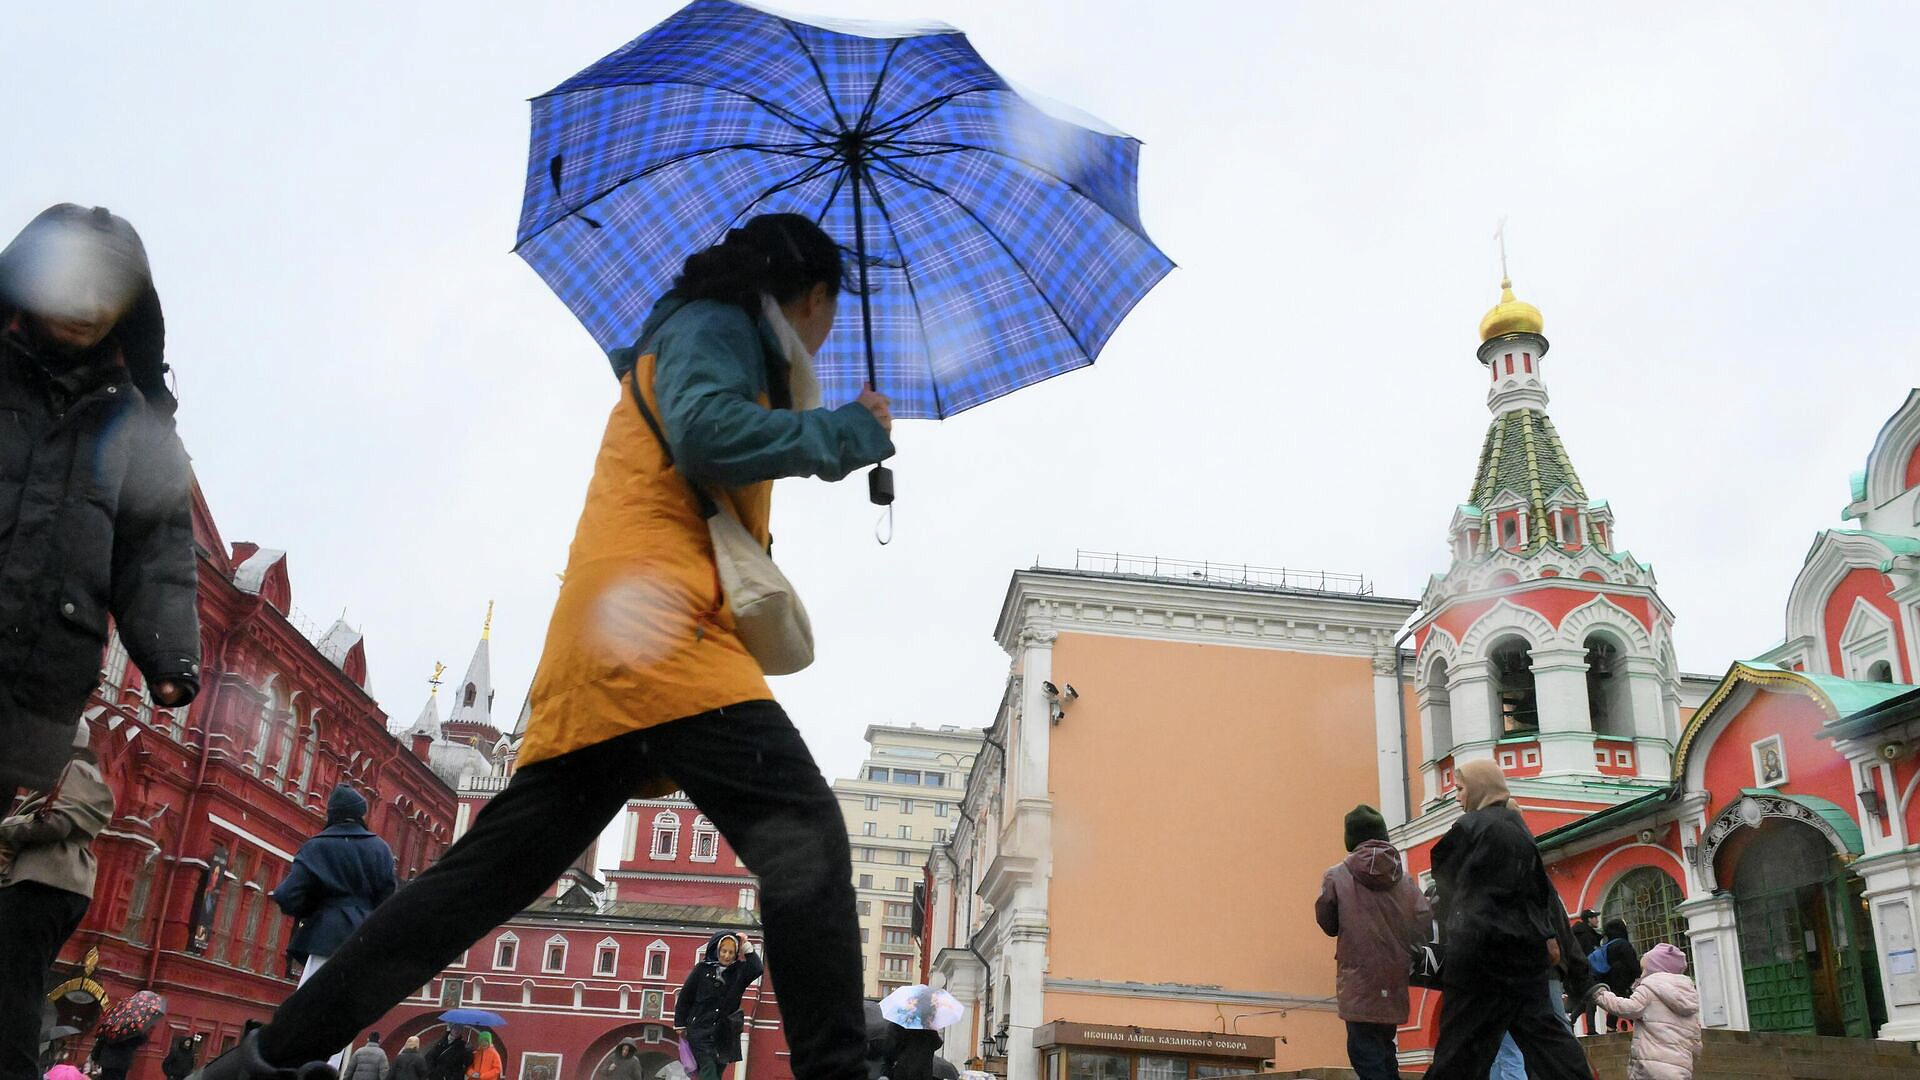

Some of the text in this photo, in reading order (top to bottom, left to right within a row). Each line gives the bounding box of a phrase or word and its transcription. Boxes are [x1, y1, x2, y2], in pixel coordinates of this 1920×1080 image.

[1083, 1031, 1247, 1050] ИКОННАЯ ЛАВКА КАЗАНСКОГО СОБОРА
